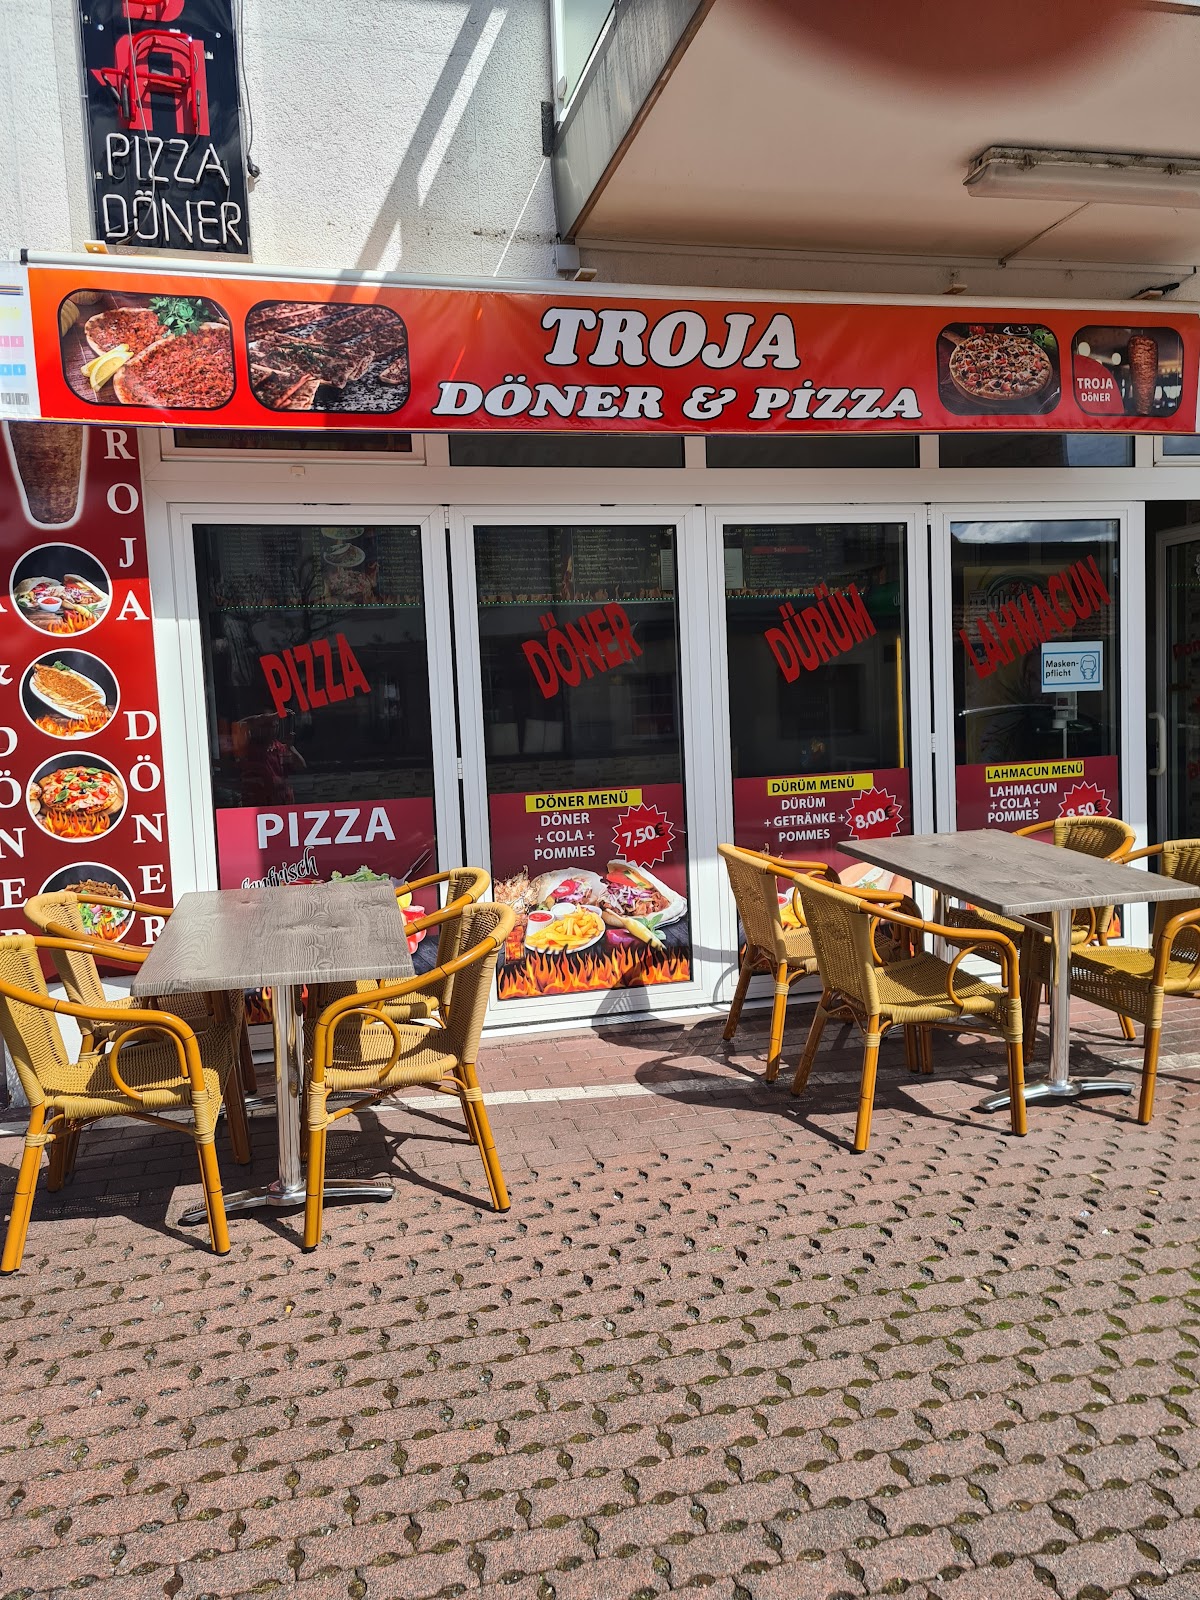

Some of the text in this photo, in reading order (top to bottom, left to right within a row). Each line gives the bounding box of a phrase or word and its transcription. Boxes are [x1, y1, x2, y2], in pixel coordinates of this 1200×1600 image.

[106, 133, 230, 187] PIZZA
[102, 190, 243, 246] DÖNER
[541, 305, 801, 370] TROJA
[1077, 378, 1114, 390] TROJA
[431, 374, 664, 421] DÖNER
[680, 385, 737, 421] &
[959, 554, 1111, 680] LAHMACUN
[764, 582, 878, 684] DÜRÜM
[521, 602, 643, 699] DÖNER
[1045, 659, 1079, 668] Masken-
[259, 632, 371, 719] PIZZA
[1045, 669, 1071, 678] pflicht
[987, 762, 1084, 780] LAHMACUN MENÜ
[772, 776, 854, 793] DÜRÜM MENÜ
[989, 782, 1058, 798] LAHMACUN
[535, 790, 628, 809] DÖNER MENÜ
[781, 796, 826, 811] DÜRÜM
[990, 797, 1041, 810] + COLA +
[540, 812, 590, 827] DÖNER
[764, 812, 845, 827] + GETRÄNKE +
[987, 808, 1040, 823] POMMES
[123, 709, 168, 946] DÖNER
[256, 806, 396, 850] PIZZA
[778, 828, 831, 843] POMMES
[534, 829, 595, 844] + COLA +
[534, 845, 596, 861] POMMES
